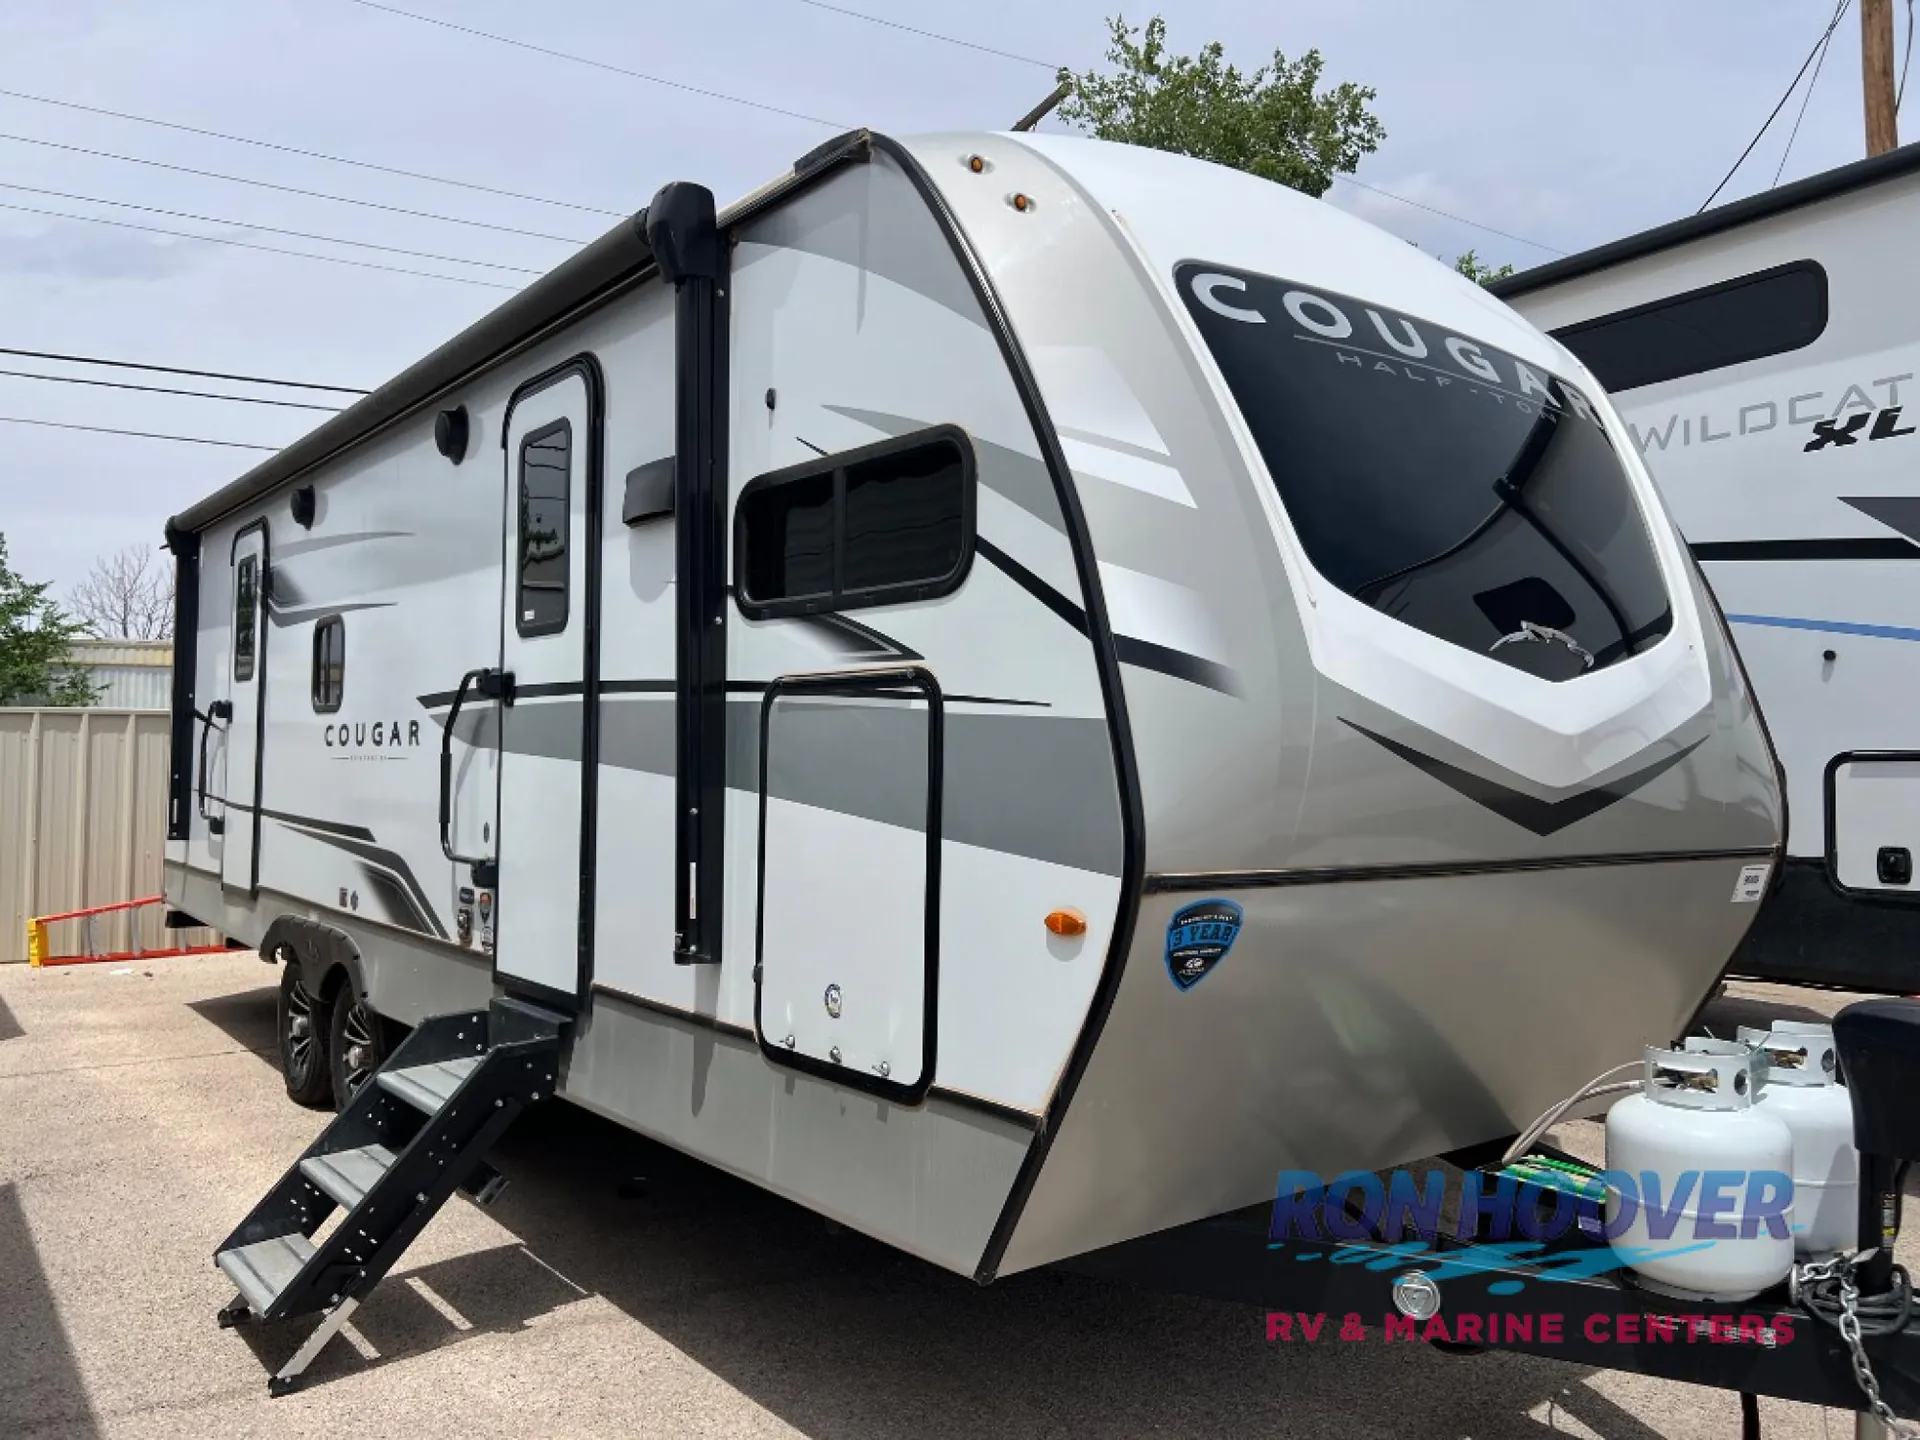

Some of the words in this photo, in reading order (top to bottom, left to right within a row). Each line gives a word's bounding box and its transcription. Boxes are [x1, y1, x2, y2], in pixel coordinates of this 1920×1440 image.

[1191, 273, 1605, 429] COUGAR
[1628, 372, 1914, 454] WILDCAT
[1803, 405, 1917, 453] XL
[324, 719, 421, 747] COUGAR
[1173, 928, 1184, 946] 3
[1189, 923, 1234, 942] YEAR
